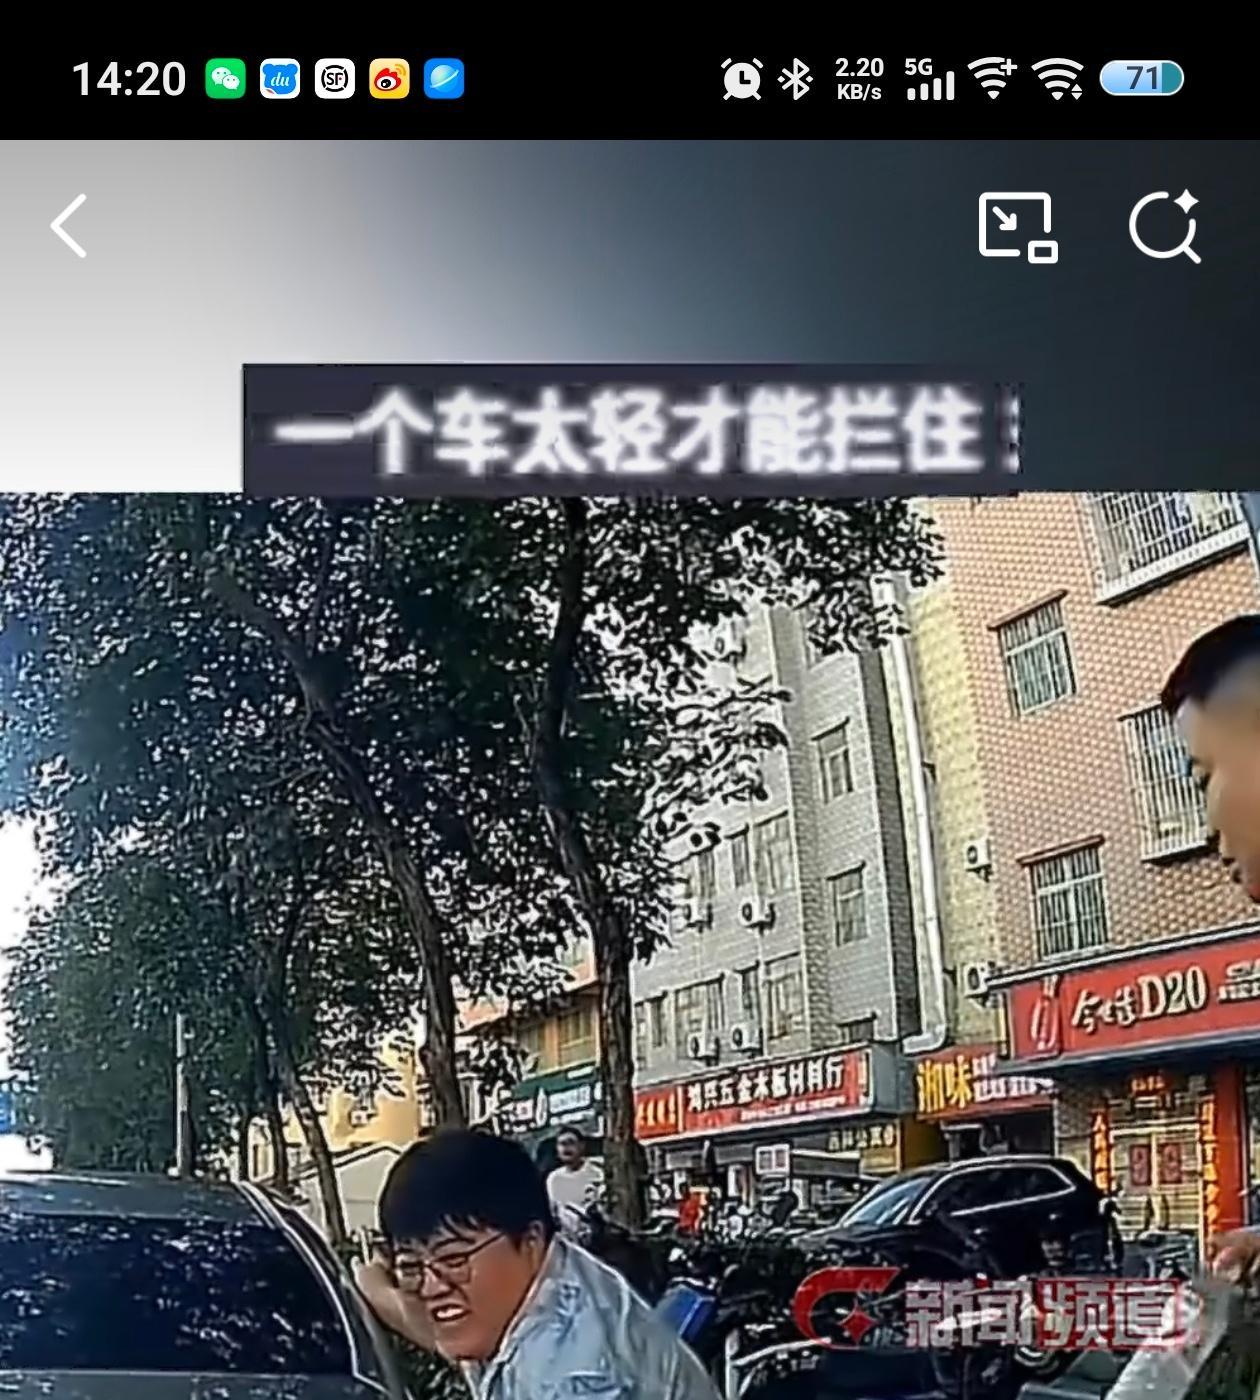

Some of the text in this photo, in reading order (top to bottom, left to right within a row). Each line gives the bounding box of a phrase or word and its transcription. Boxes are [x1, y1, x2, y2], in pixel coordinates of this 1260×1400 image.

[836, 58, 883, 76] 2.20
[905, 58, 932, 75] 5G
[74, 62, 185, 96] 14:20
[1127, 66, 1157, 90] 71
[838, 84, 881, 100] KB/s
